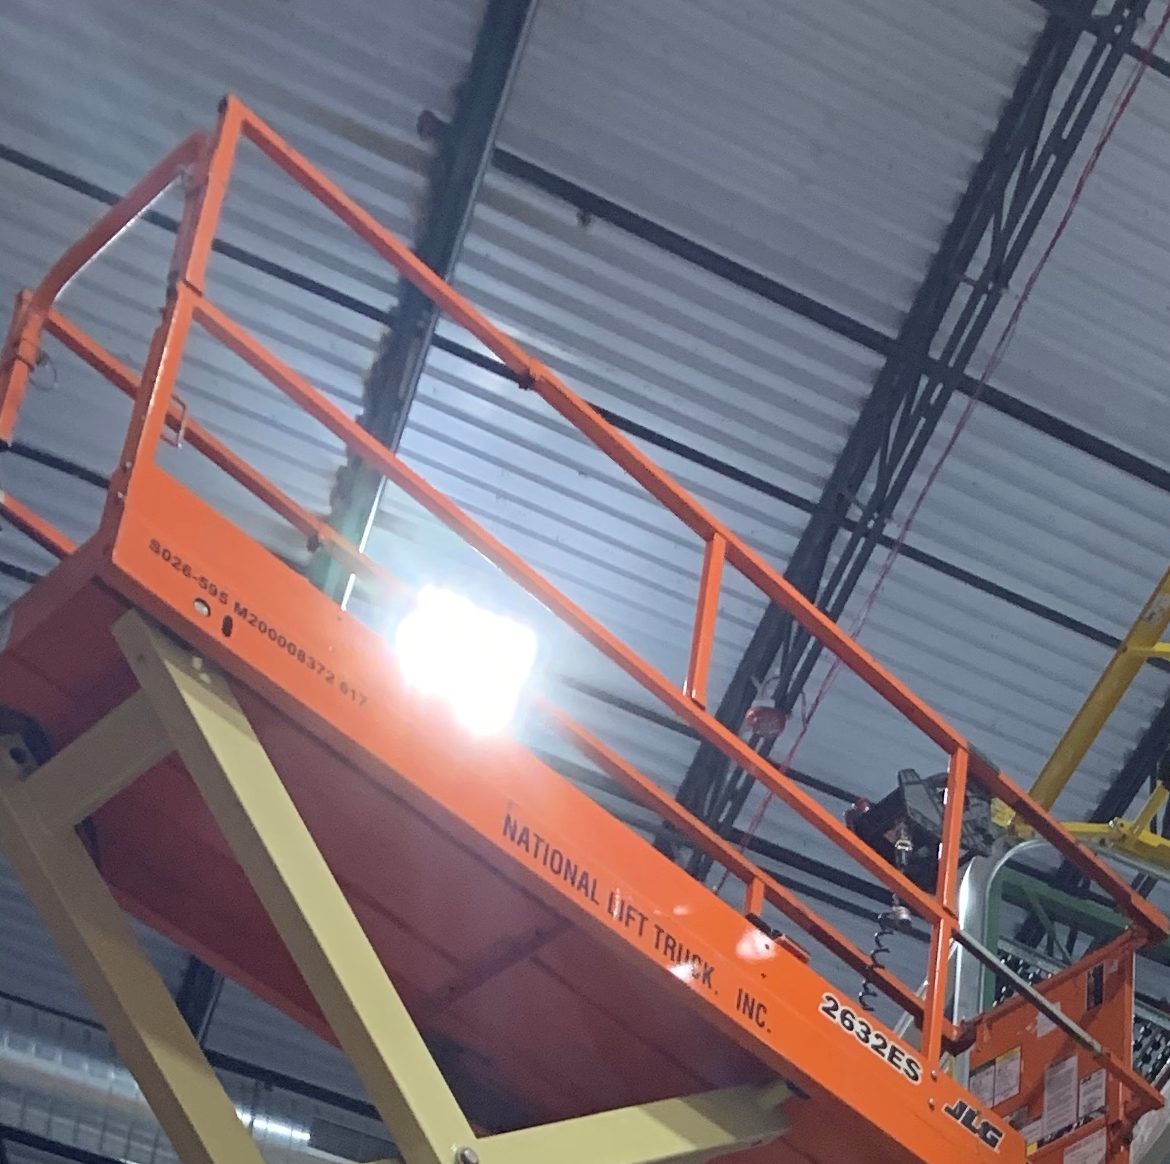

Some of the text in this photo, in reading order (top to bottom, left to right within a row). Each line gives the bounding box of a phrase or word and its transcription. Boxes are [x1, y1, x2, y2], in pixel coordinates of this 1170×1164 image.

[502, 812, 600, 906] NATIONAL
[607, 891, 648, 937] LIFT
[736, 988, 772, 1033] INC.
[818, 993, 923, 1084] 2632ES
[943, 1098, 1005, 1152] JLG
